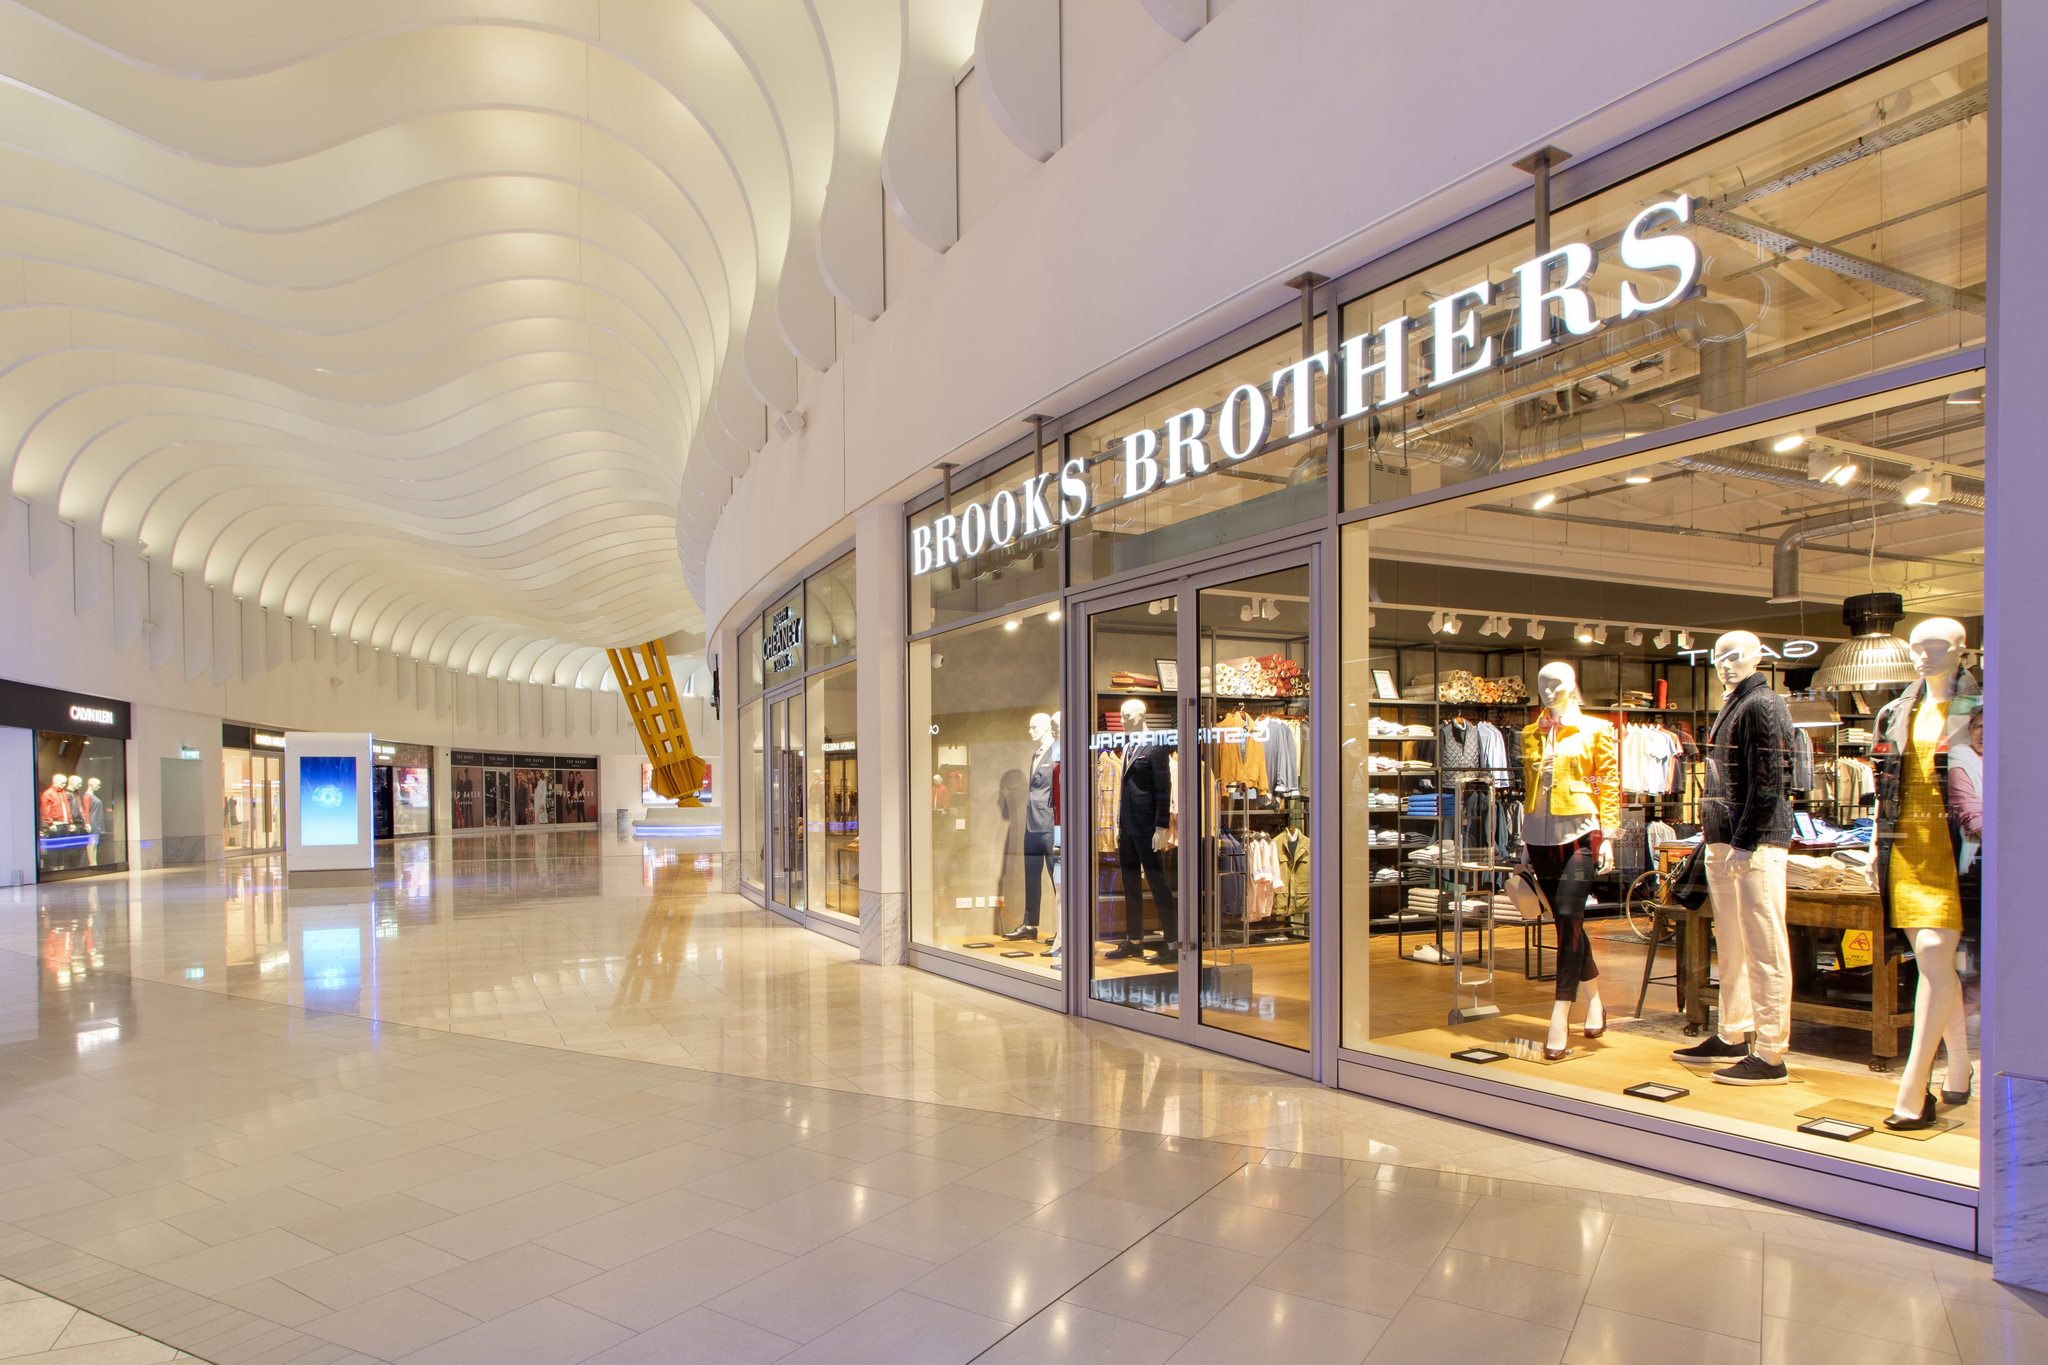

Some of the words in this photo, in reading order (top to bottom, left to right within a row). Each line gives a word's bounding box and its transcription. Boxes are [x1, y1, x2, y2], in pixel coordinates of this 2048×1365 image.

[912, 457, 1091, 576] BROOKS
[1123, 194, 1702, 499] BROTHERS
[763, 617, 802, 660] CHEANEY
